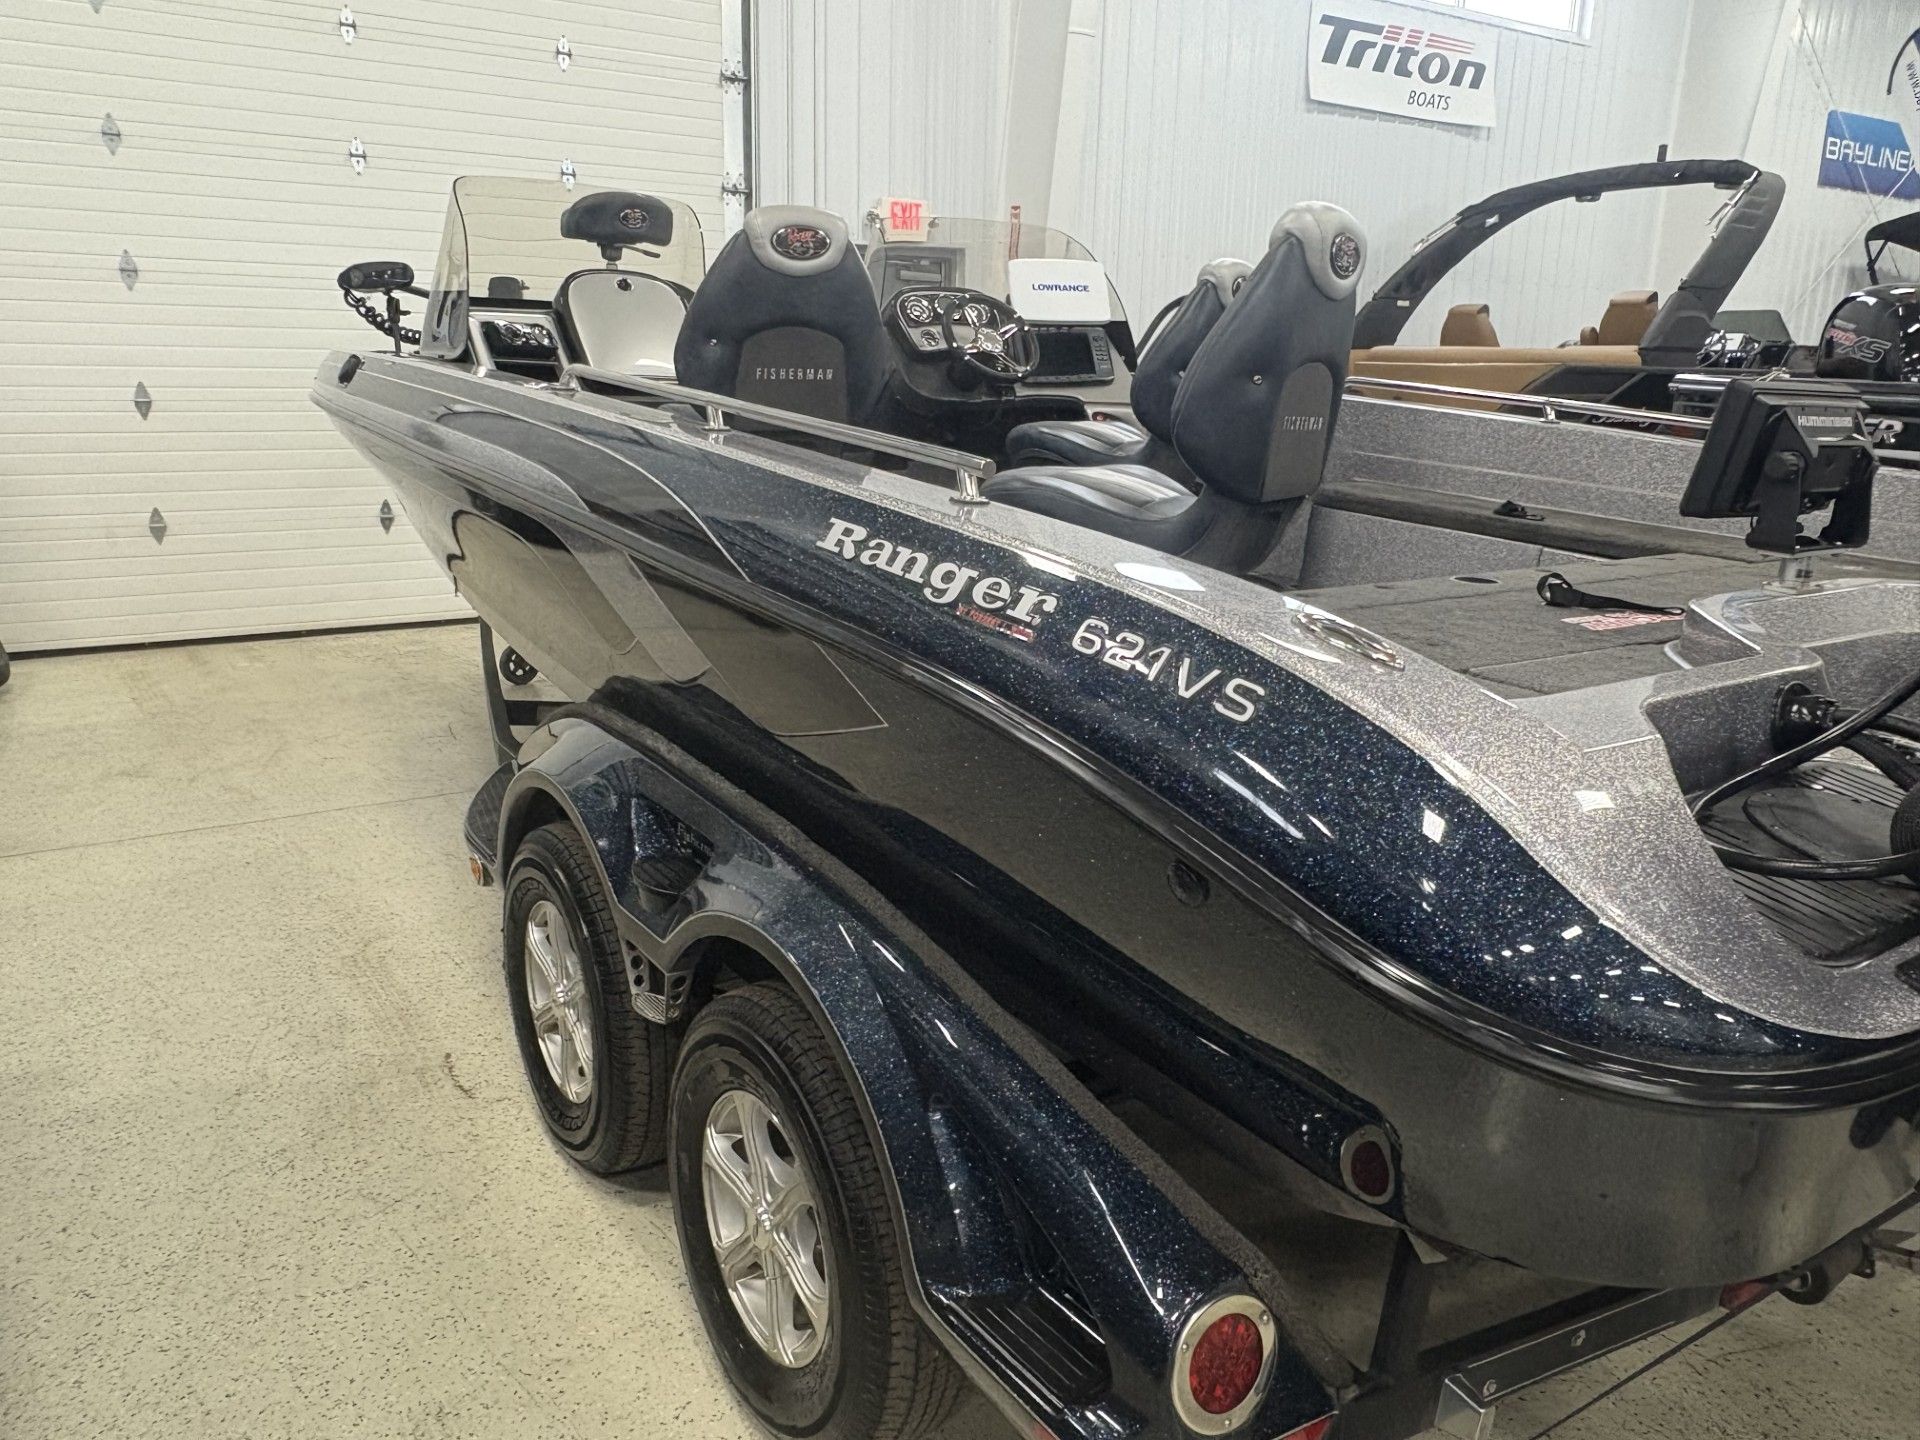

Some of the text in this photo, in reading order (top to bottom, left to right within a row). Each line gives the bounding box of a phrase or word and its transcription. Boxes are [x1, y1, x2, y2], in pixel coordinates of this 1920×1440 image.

[1319, 14, 1486, 90] Triton
[1407, 90, 1451, 111] BOATS
[1825, 136, 1914, 172] BAYLINE
[891, 201, 922, 231] EXIT
[1032, 283, 1090, 292] LOWRANCE
[756, 367, 833, 380] FISHERMAN
[815, 517, 1058, 623] Ranger
